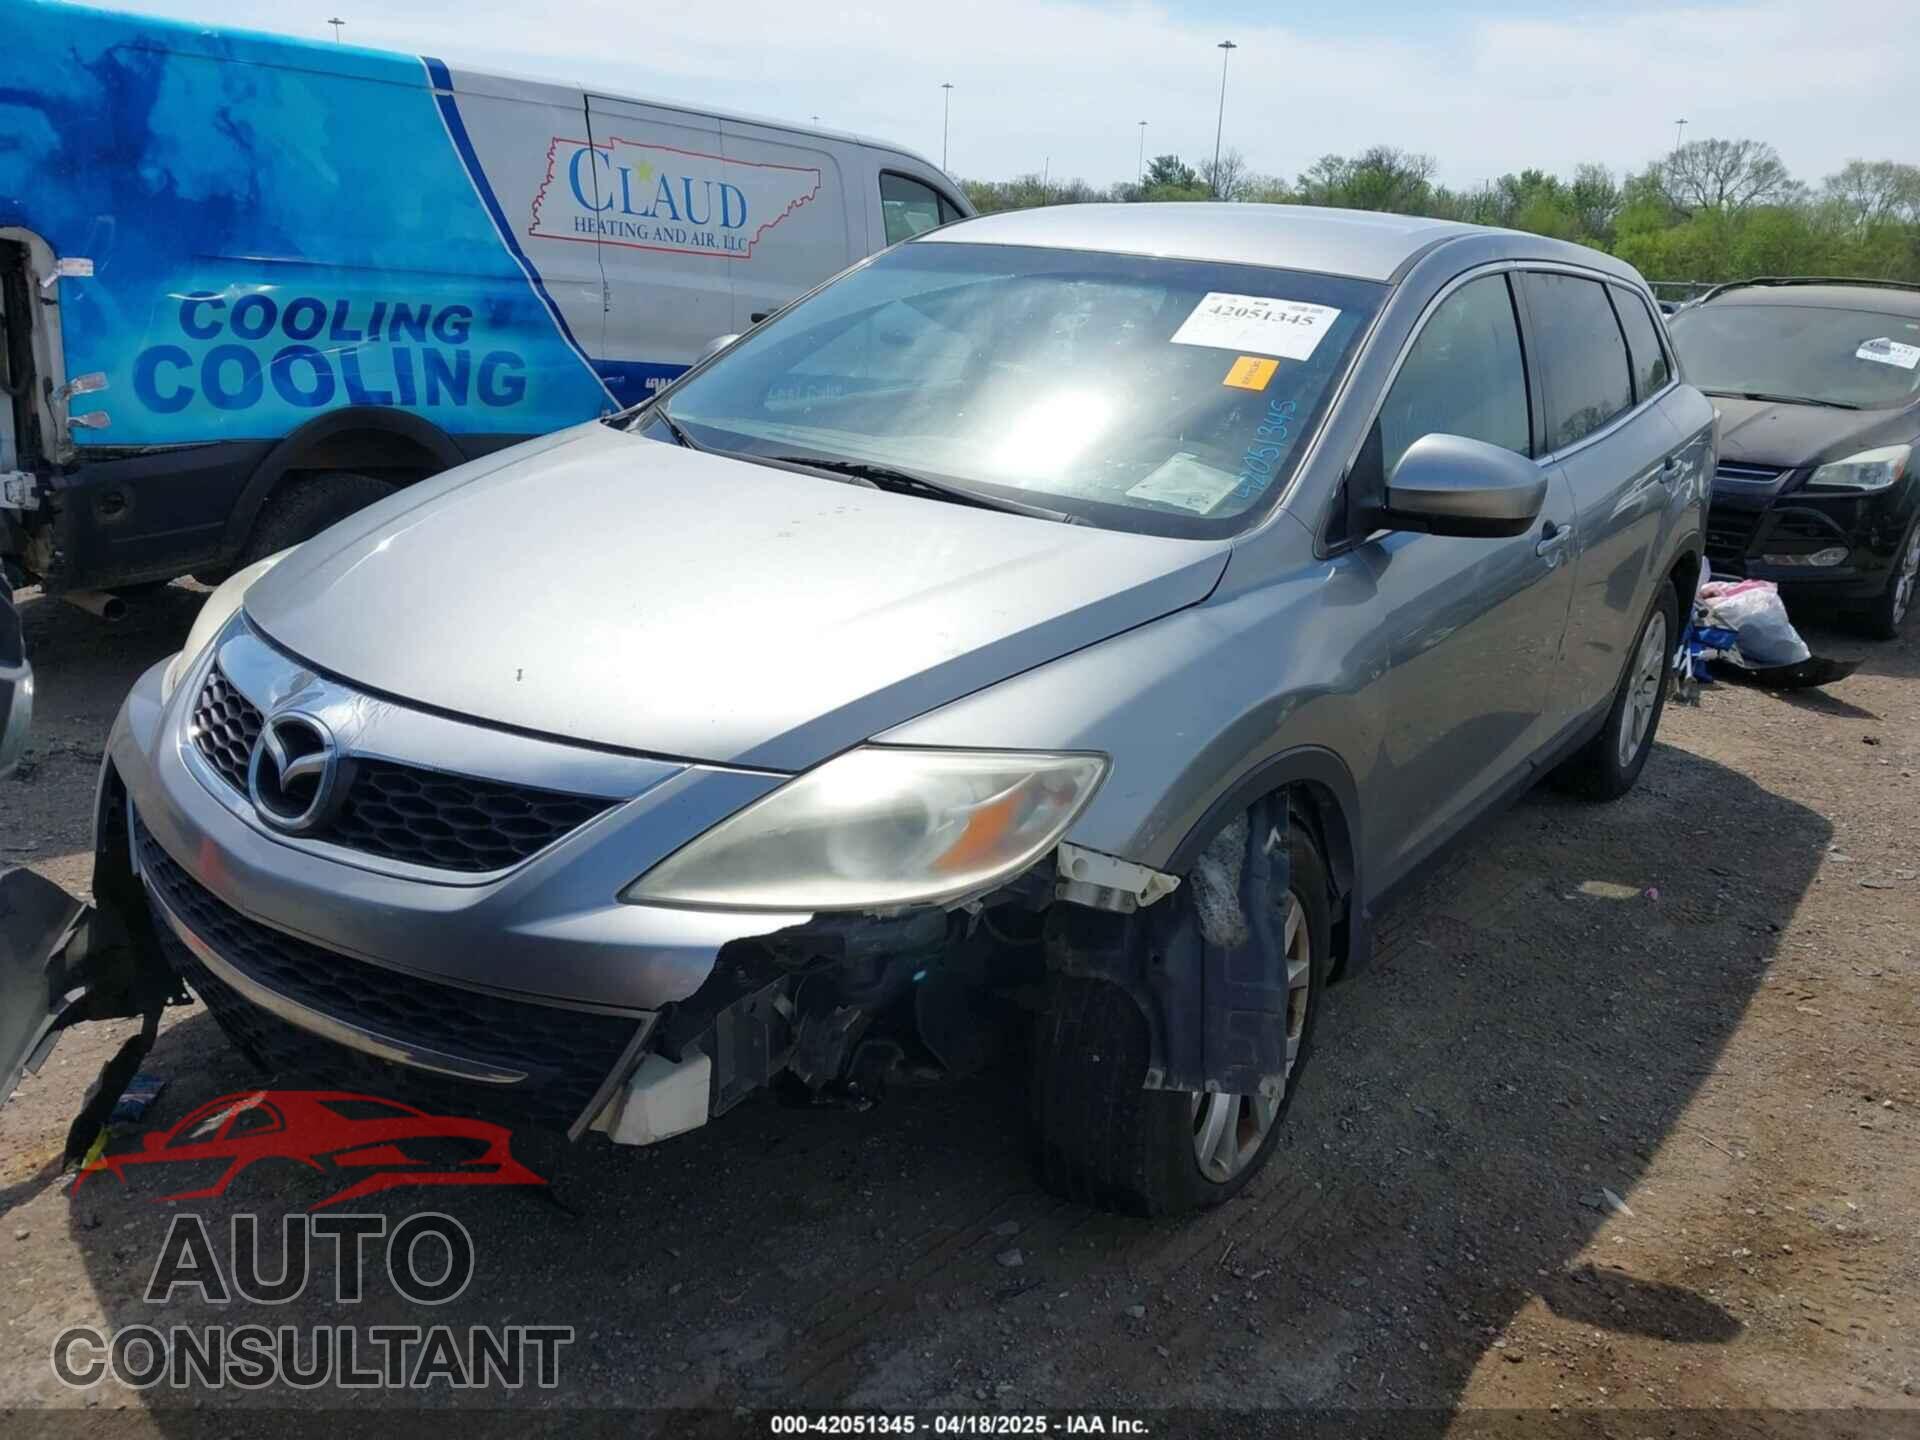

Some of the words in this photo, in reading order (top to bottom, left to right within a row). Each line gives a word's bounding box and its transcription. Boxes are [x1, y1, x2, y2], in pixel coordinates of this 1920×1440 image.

[569, 147, 747, 230] CLAUD
[574, 215, 649, 241] HEATING
[653, 226, 687, 245] AND
[723, 235, 748, 252] LLC
[179, 291, 473, 345] COOLING
[1208, 303, 1316, 327] 42051345
[132, 343, 528, 415] COOLING
